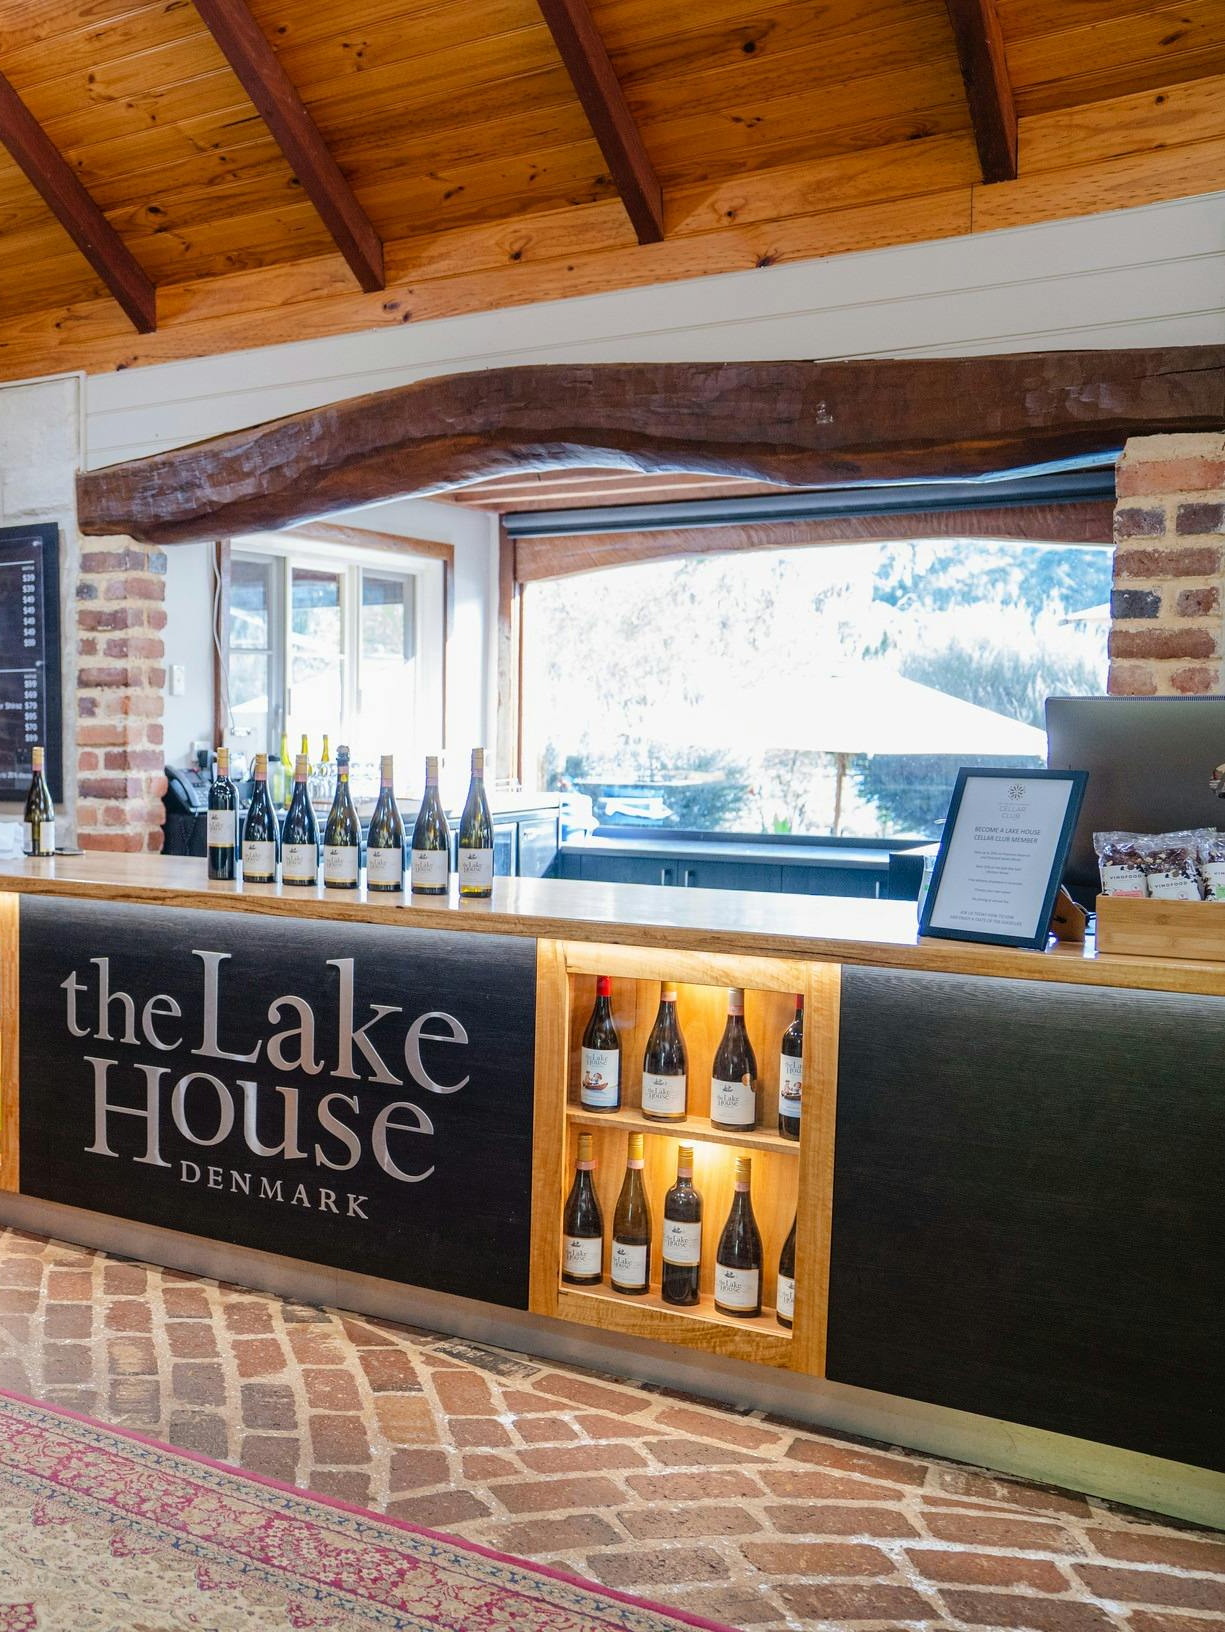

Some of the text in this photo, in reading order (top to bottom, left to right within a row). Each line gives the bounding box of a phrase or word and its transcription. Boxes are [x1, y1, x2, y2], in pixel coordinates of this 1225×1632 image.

[60, 949, 470, 1095] the Lake
[83, 1056, 435, 1183] House
[180, 1160, 370, 1221] DENMARK
